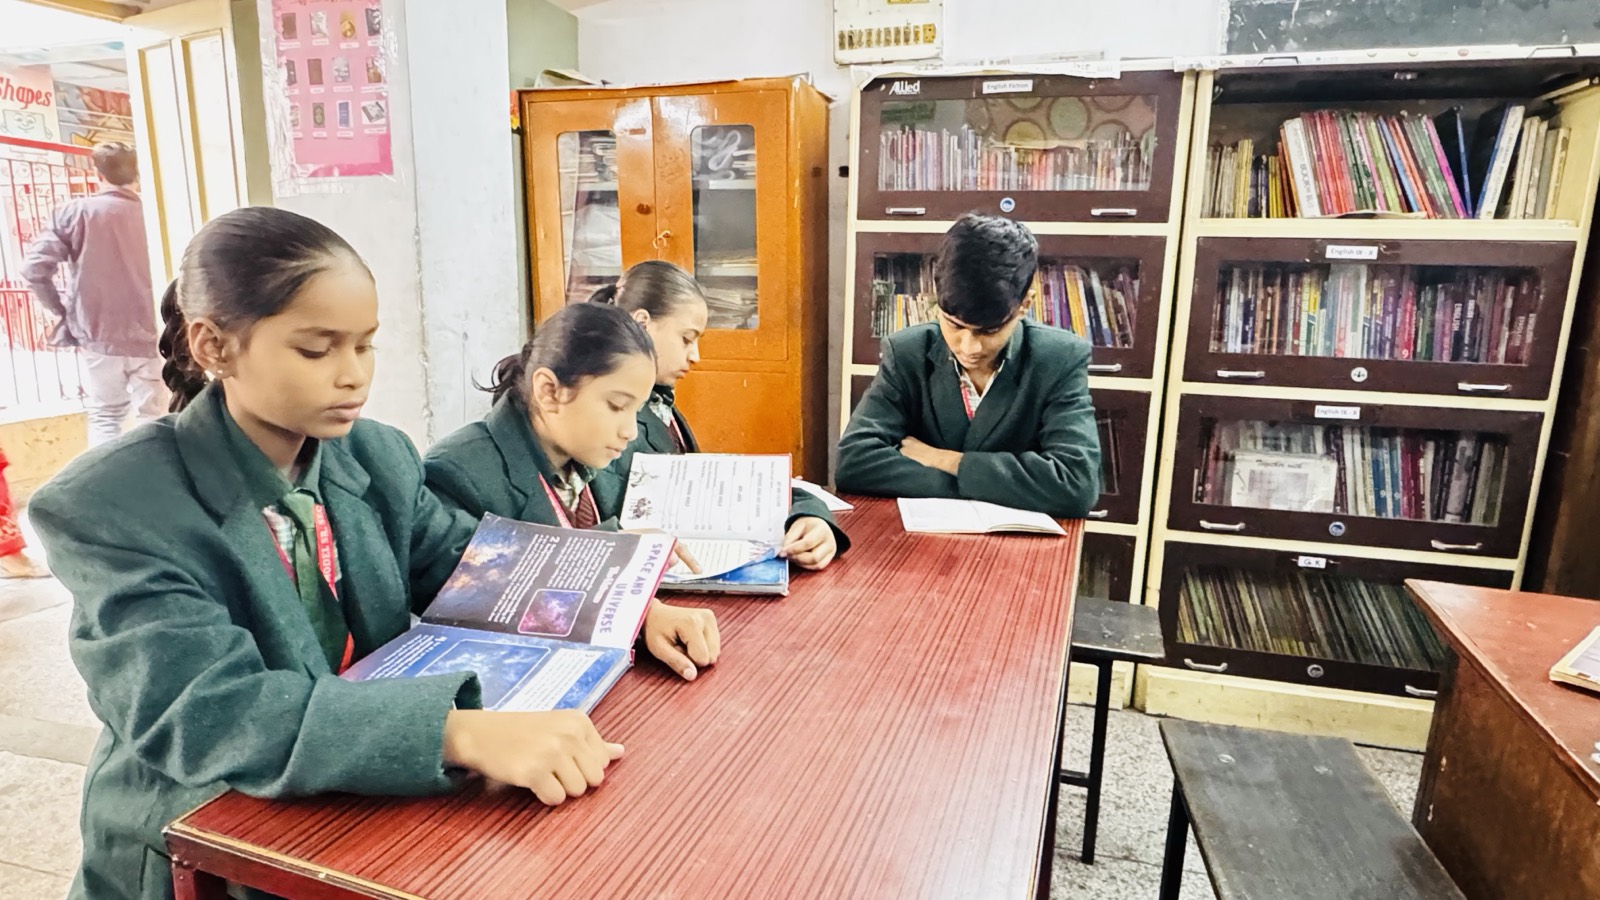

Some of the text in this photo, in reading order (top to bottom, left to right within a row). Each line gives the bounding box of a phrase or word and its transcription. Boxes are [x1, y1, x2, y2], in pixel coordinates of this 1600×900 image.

[987, 83, 1007, 91] English
[1331, 248, 1354, 256] English
[1453, 303, 1462, 331] ENGLISH
[1317, 408, 1339, 416] English
[630, 543, 662, 596] SPACE AND
[600, 583, 627, 634] UNIVERSE
